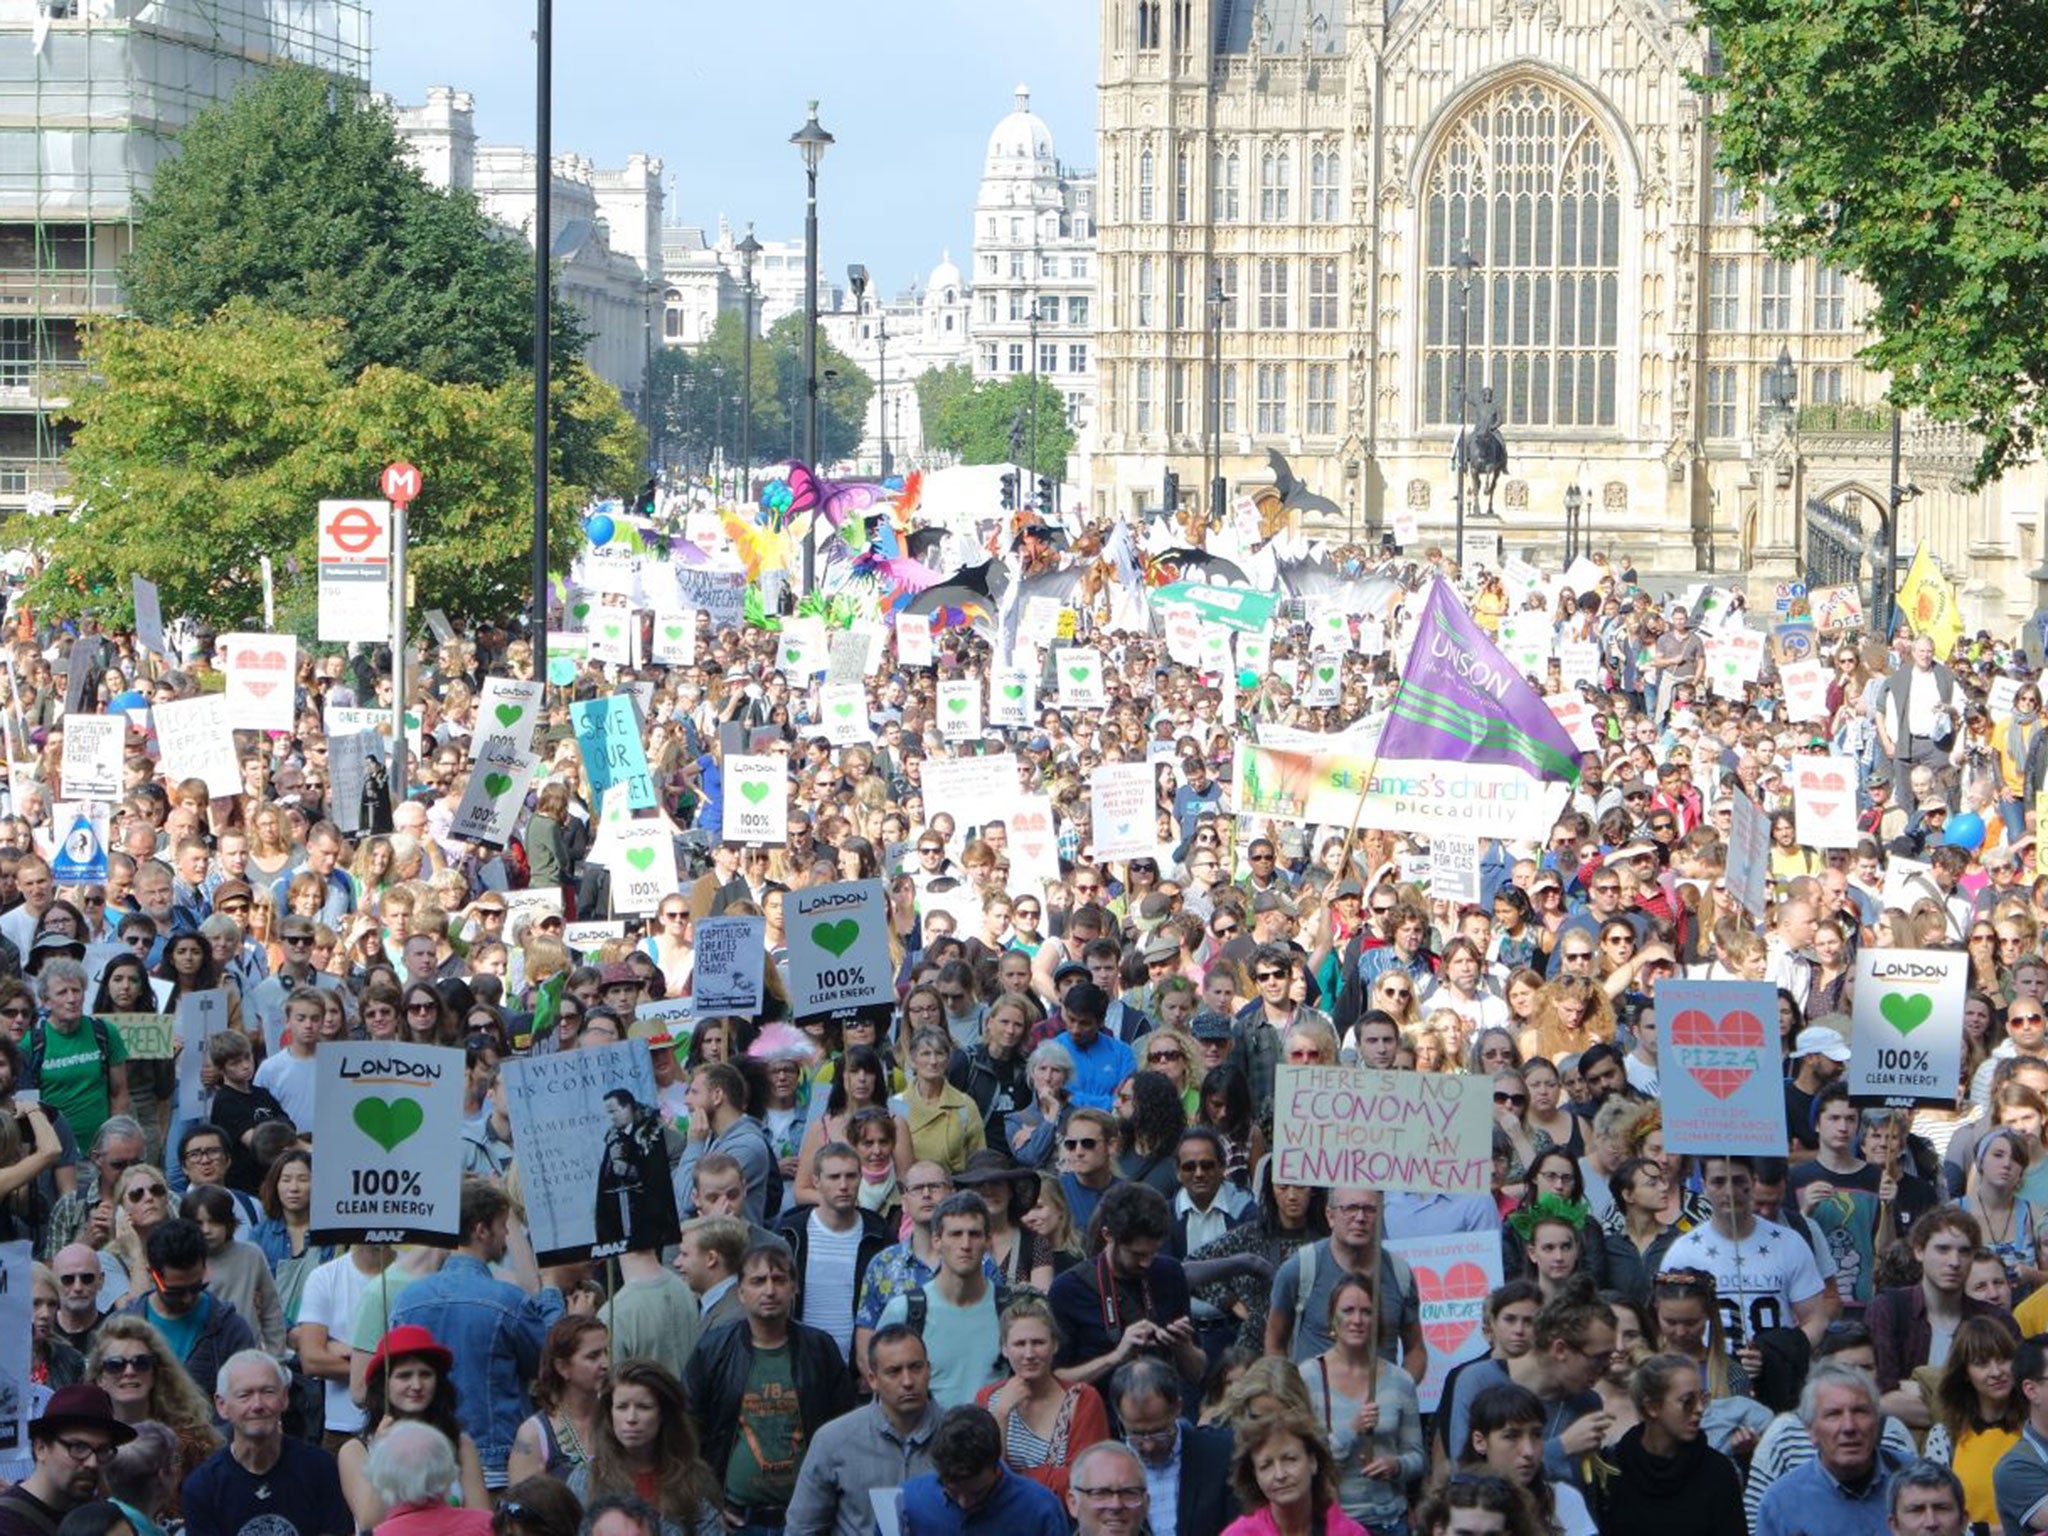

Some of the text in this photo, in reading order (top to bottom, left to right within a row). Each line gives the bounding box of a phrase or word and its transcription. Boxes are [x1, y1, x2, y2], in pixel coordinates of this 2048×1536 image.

[388, 469, 414, 495] M
[1431, 632, 1512, 700] UNSON
[493, 685, 534, 698] LONDON
[580, 710, 629, 740] SAVE
[595, 744, 631, 772] OUR
[1451, 773, 1529, 801] church
[471, 806, 499, 825] 100%
[740, 813, 770, 827] 100%
[1395, 801, 1517, 823] piccadilly
[1433, 839, 1475, 857] NO DASH
[1434, 852, 1474, 871] FOR GAS
[629, 881, 660, 897] 100%
[798, 891, 870, 915] LONDON
[568, 930, 614, 942] LONDON
[699, 927, 752, 943] CAPITALISM
[699, 939, 738, 953] CREATES
[698, 951, 736, 964] CLIMATE
[1871, 959, 1949, 978] LONDON
[698, 963, 728, 976] CHAOS
[815, 966, 867, 991] 100%
[809, 985, 877, 1006] CLEAN ENERGY
[643, 1008, 692, 1022] LONDO
[340, 1056, 442, 1079] LONDON
[531, 1050, 622, 1079] WINTER
[1681, 1047, 1760, 1072] PIZZA
[1877, 1048, 1929, 1072] 100%
[516, 1065, 643, 1099] IS COMING
[1286, 1068, 1464, 1101] THERE'S NO
[1865, 1072, 1938, 1087] CLEAN ENERGY
[1290, 1089, 1461, 1133] ECONOMY
[1283, 1122, 1462, 1157] WITHOUT AN
[1279, 1147, 1489, 1189] ENVIRONMENT
[352, 1169, 422, 1197] 100%
[336, 1201, 435, 1217] CLEAN ENERGY
[1718, 1274, 1783, 1290] OOKLYN
